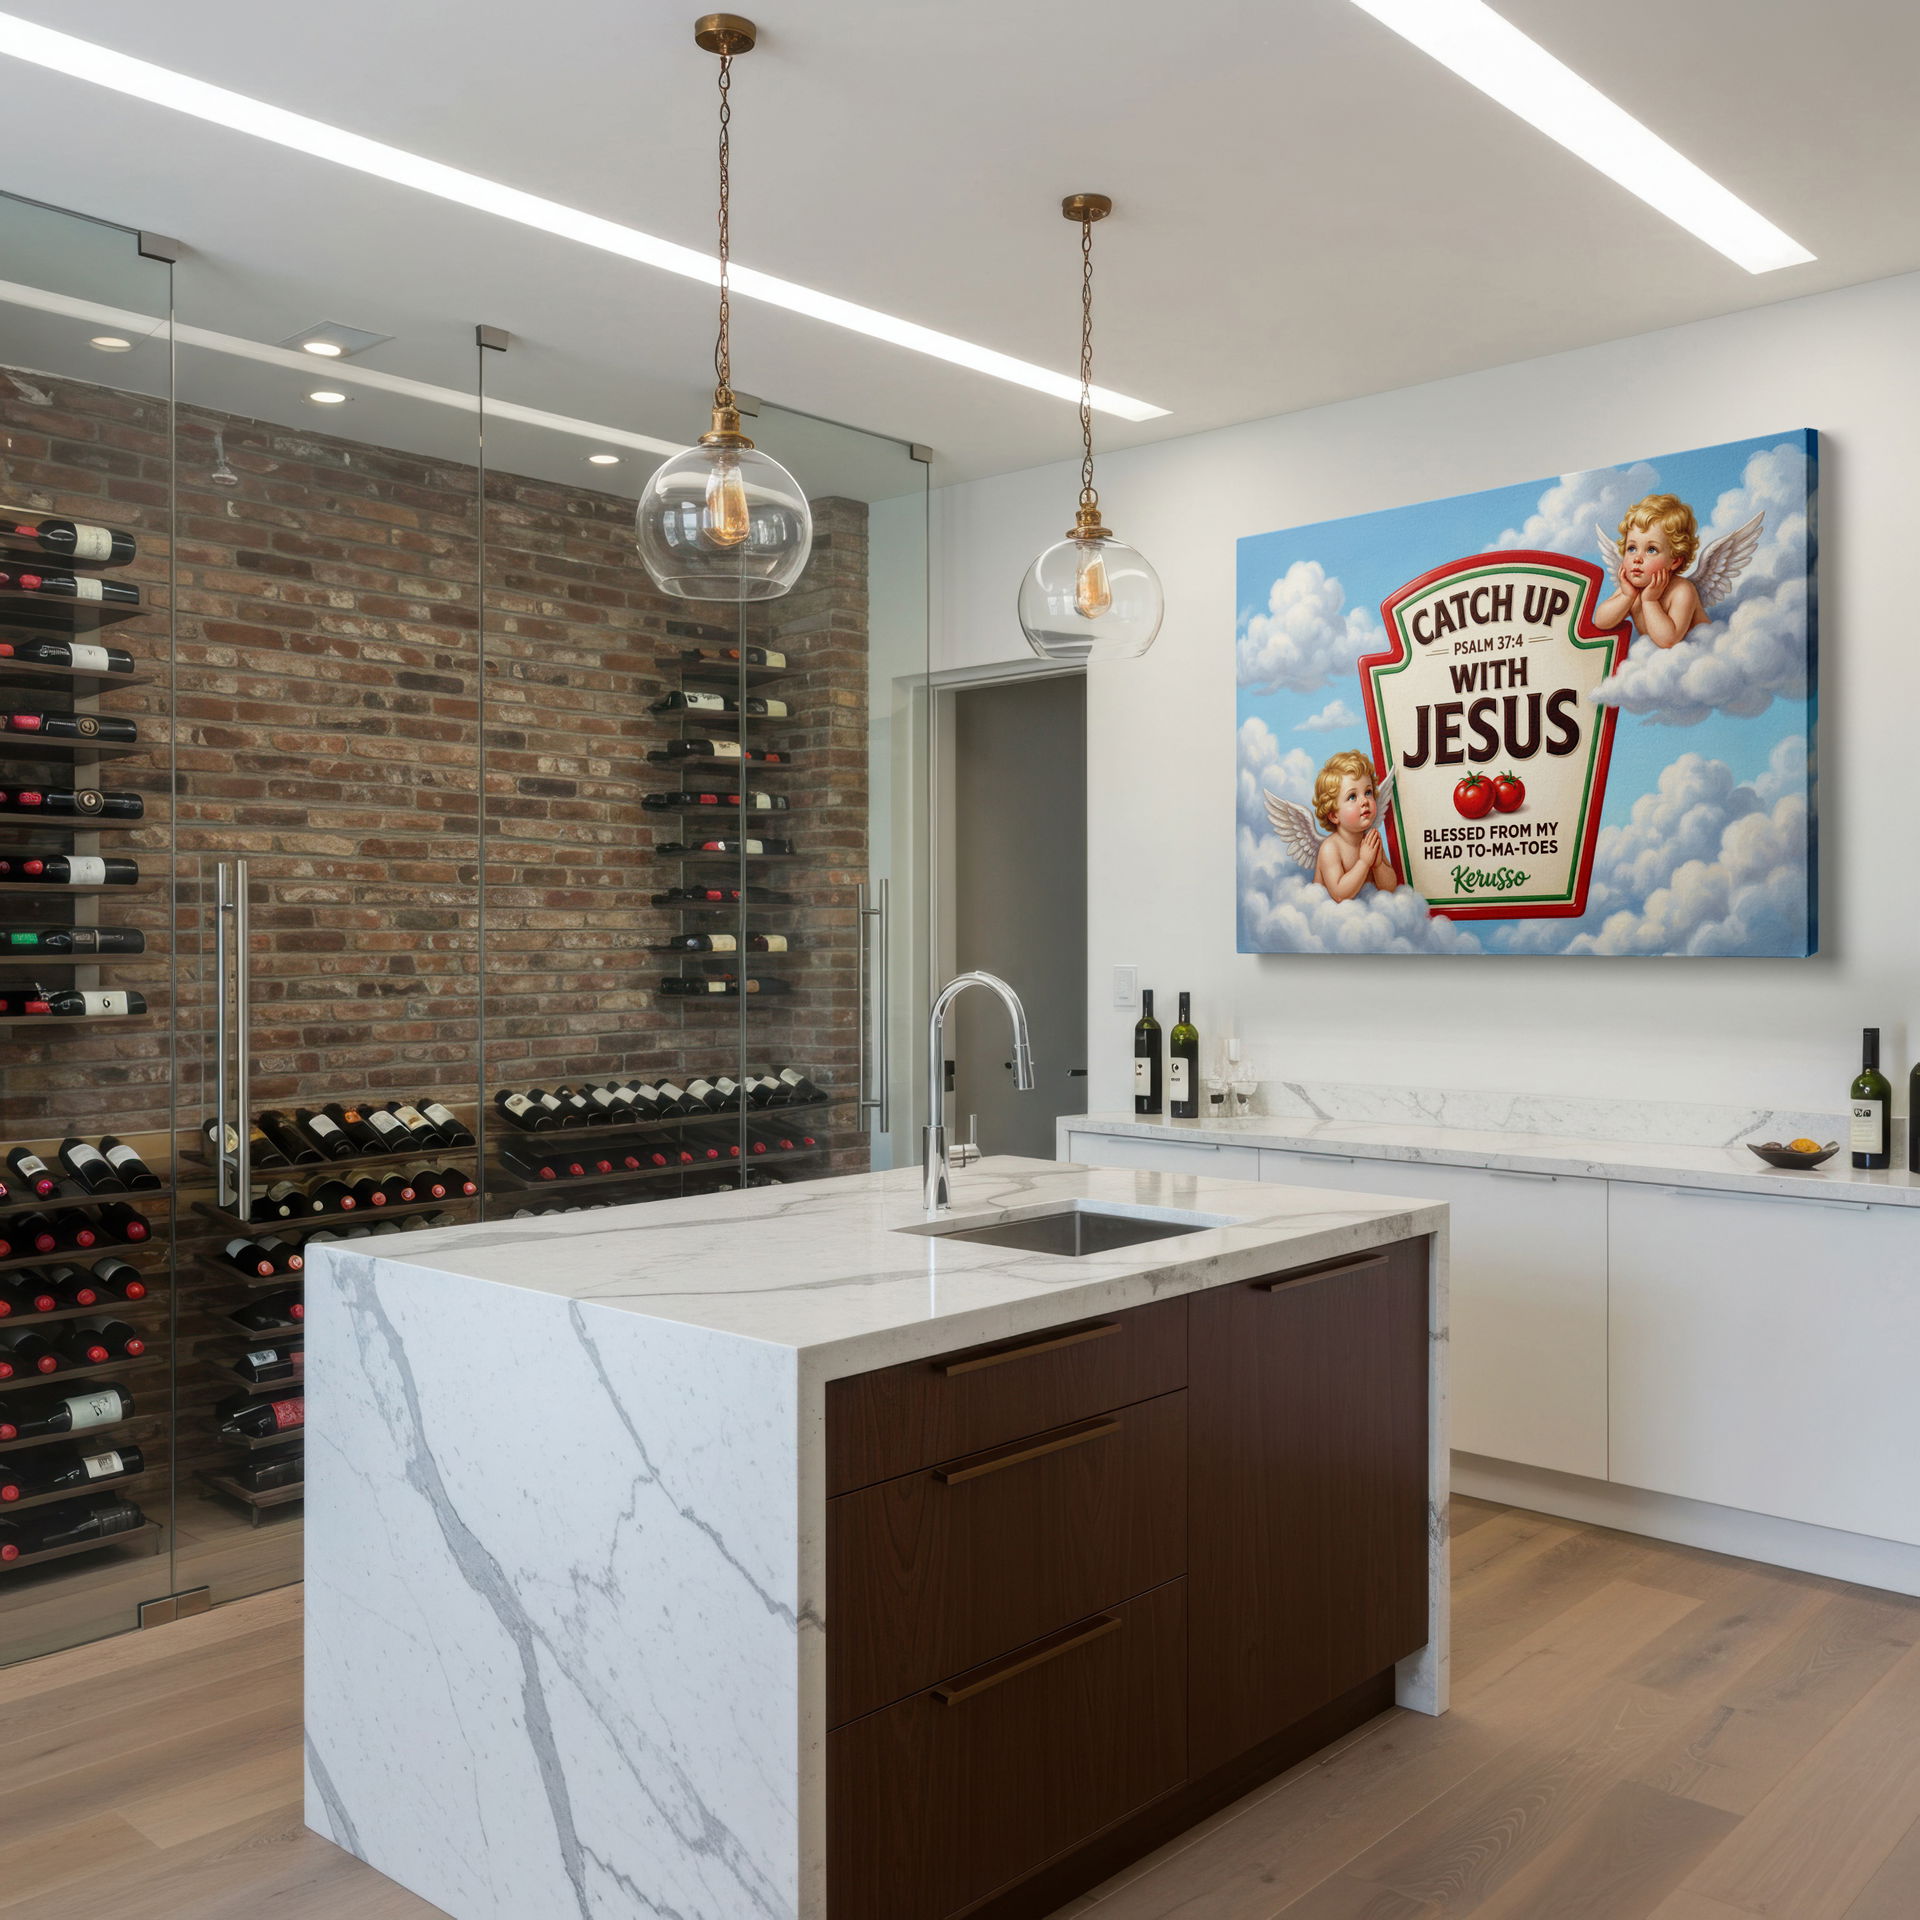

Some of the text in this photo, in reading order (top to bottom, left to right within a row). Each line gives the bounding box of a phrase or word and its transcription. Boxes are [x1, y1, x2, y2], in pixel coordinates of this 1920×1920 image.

[1412, 584, 1570, 645] CATCH UP
[1454, 634, 1524, 656] PSALM 37:4
[1449, 656, 1528, 693] WITH
[1403, 688, 1580, 769] JESUS
[1423, 822, 1559, 843] BLESSED FROM MY
[1424, 840, 1559, 860] HEAD TO-MA-TOES
[1450, 864, 1531, 894] Kerusso
